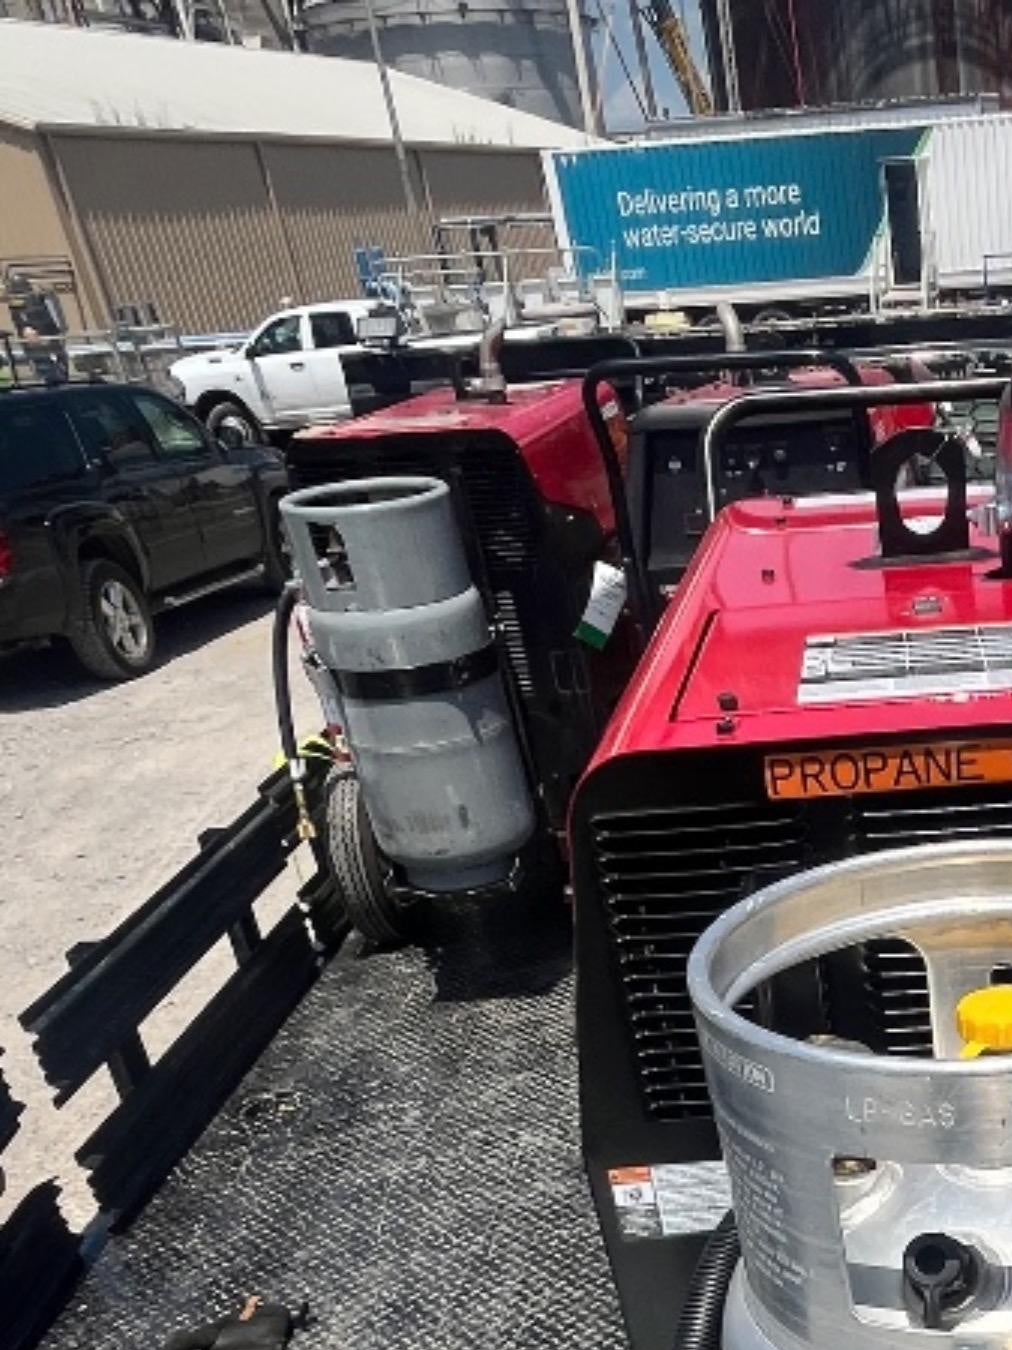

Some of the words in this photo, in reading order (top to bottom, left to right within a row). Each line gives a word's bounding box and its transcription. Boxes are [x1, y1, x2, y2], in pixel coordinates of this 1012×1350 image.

[617, 186, 721, 217] Delivering
[725, 188, 739, 208] a
[743, 183, 801, 208] more
[624, 221, 757, 248] water-secure
[761, 210, 820, 238] world
[768, 744, 985, 796] PROPANE
